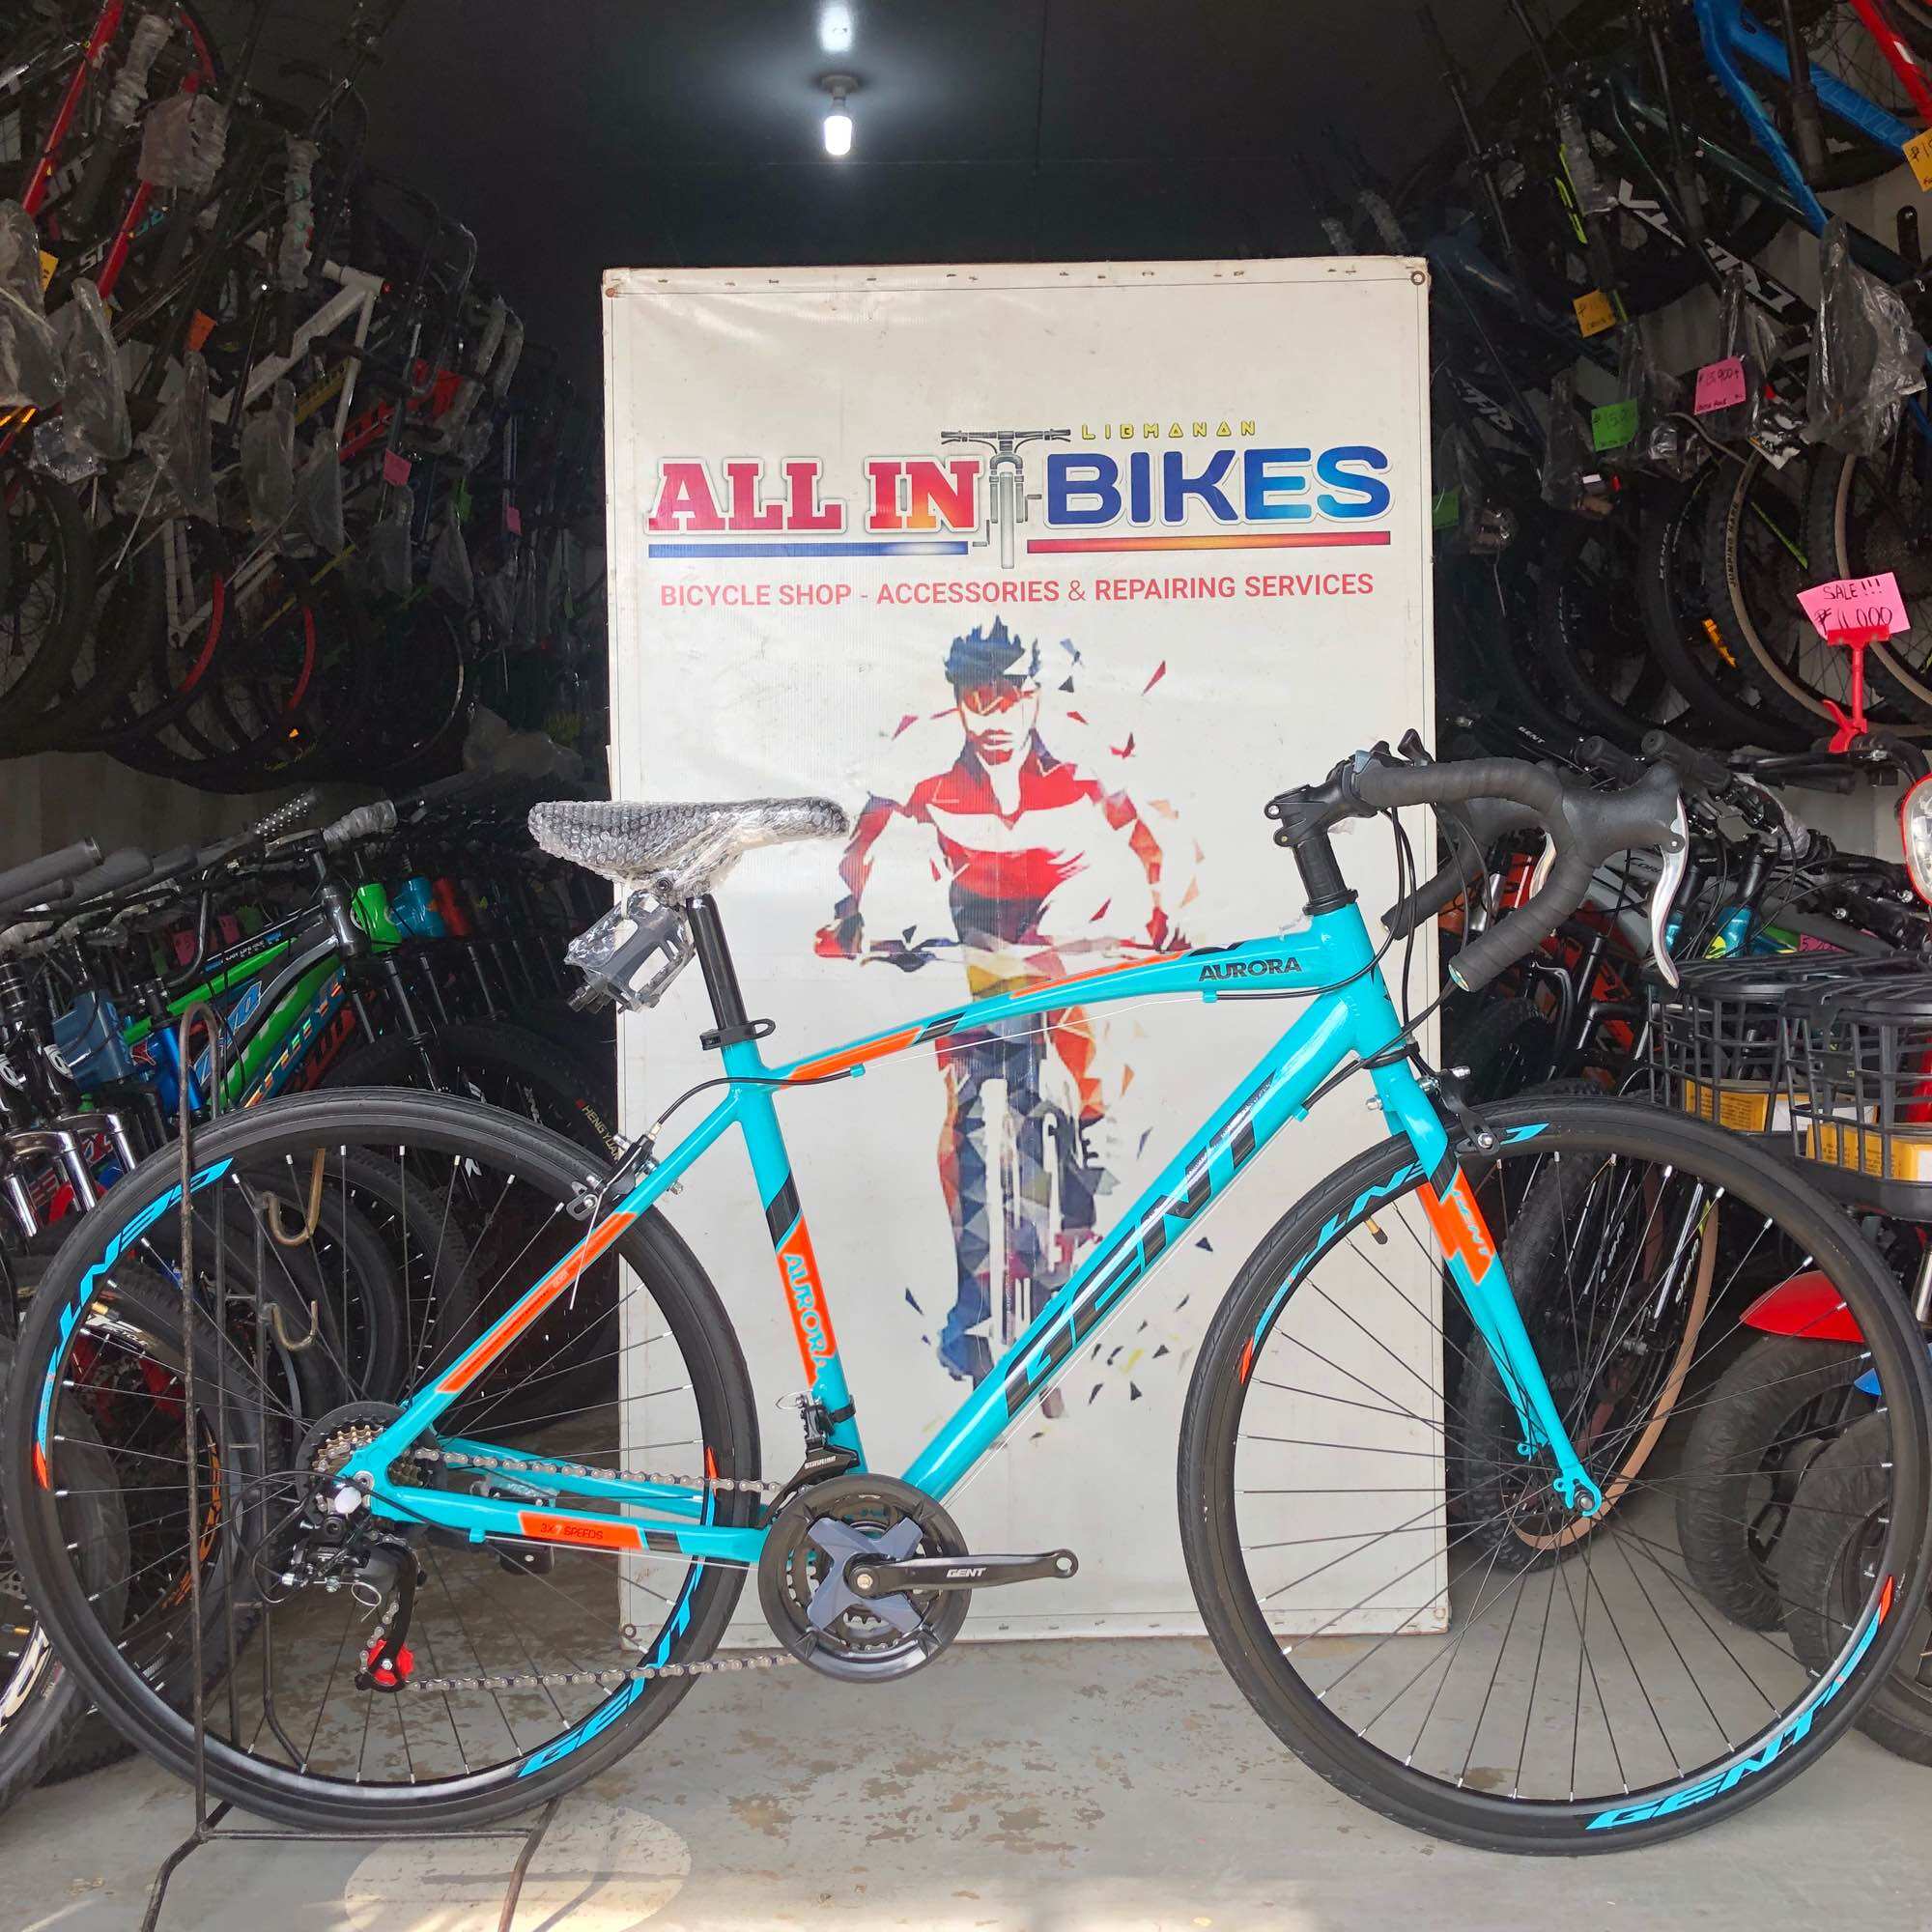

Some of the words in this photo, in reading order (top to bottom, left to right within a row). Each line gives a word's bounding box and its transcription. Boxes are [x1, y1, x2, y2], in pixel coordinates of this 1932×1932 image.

[1081, 419, 1257, 440] LIBMANAN
[647, 462, 843, 531] ALL
[869, 460, 980, 529] IN
[1046, 445, 1391, 526] BIKES
[660, 583, 771, 607] BICYCLE
[778, 582, 852, 606] SHOP
[876, 579, 1061, 605] ACCESSORIES
[1067, 580, 1087, 602] &
[1094, 576, 1236, 602] REPAIRING
[1243, 573, 1375, 598] SERVICES
[1198, 956, 1303, 982] AURORA
[581, 1103, 607, 1136] HENG
[1005, 1067, 1276, 1419] GENT
[563, 1525, 604, 1541] SPEEDS
[946, 1566, 987, 1578] GENT
[1584, 1690, 1829, 1832] GENT
